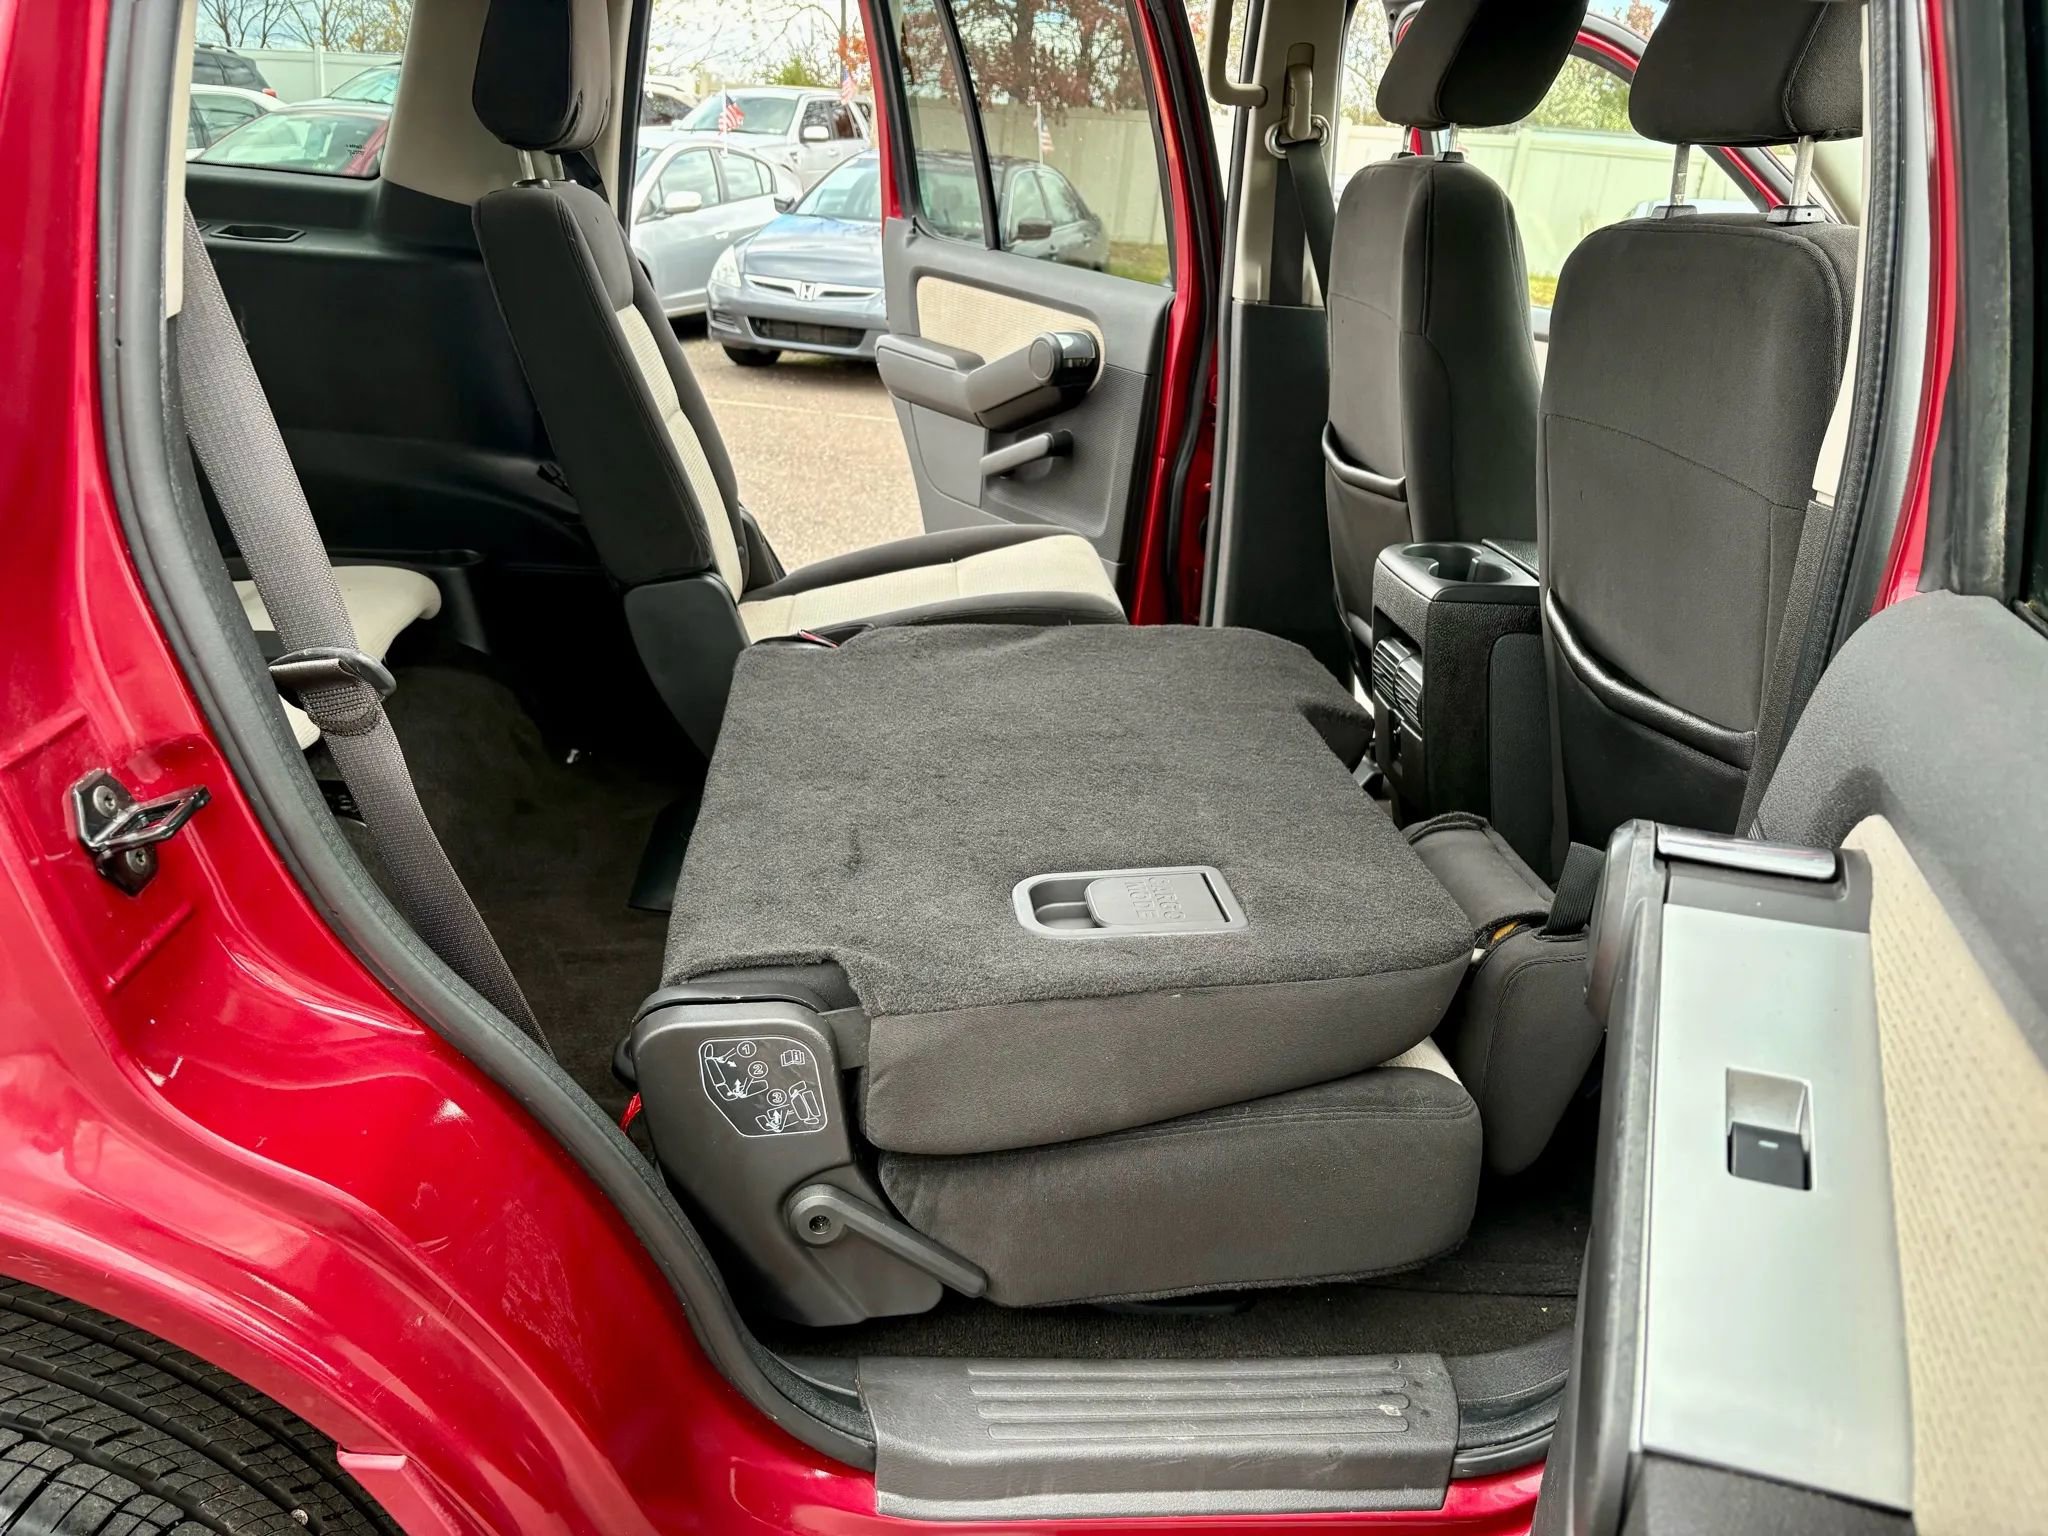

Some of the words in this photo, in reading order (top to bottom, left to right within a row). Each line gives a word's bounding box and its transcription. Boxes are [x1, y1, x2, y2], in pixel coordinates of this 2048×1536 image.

[1125, 881, 1158, 920] MODE
[1148, 877, 1186, 920] CARGO
[742, 1044, 751, 1056] 1
[753, 1064, 764, 1075] 2
[772, 1092, 783, 1103] 3
